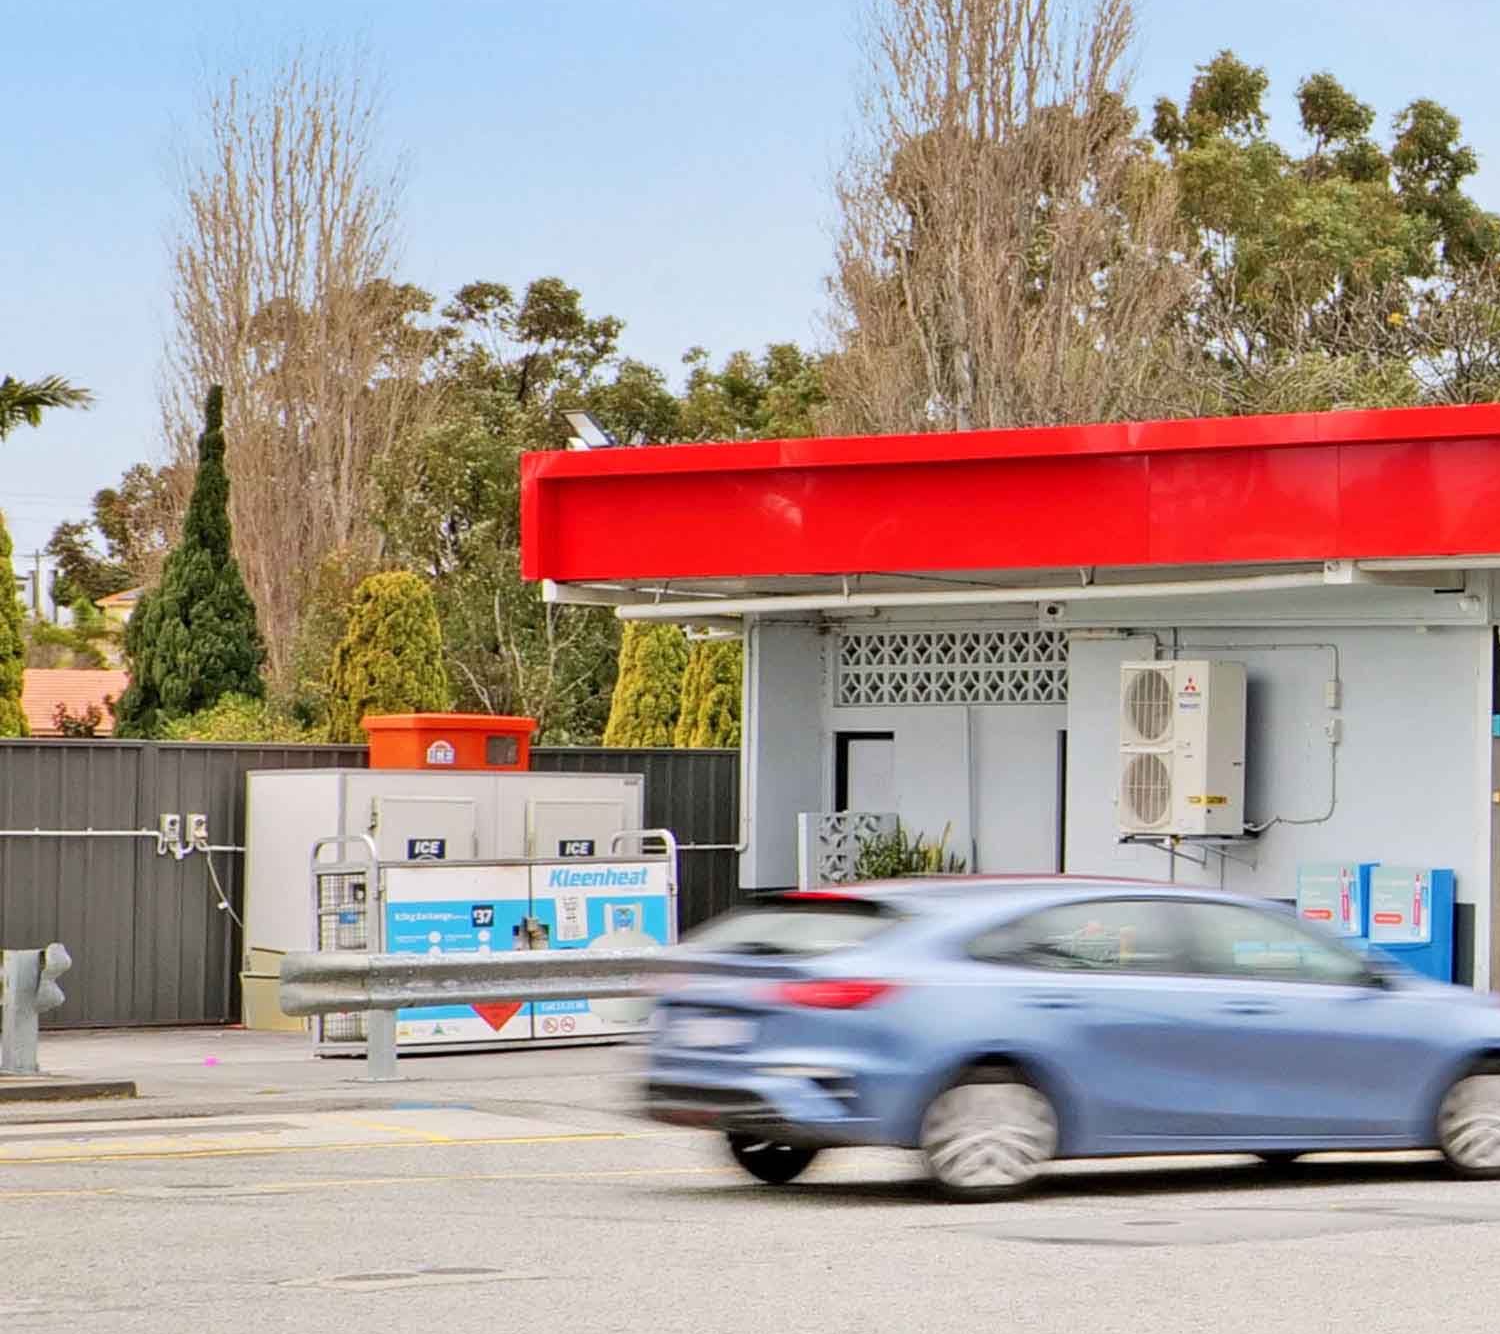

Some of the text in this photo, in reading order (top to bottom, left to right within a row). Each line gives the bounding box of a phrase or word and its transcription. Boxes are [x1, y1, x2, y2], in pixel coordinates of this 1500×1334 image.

[414, 840, 440, 854] ICE
[566, 842, 589, 855] ICE
[550, 866, 649, 888] Kleenheat
